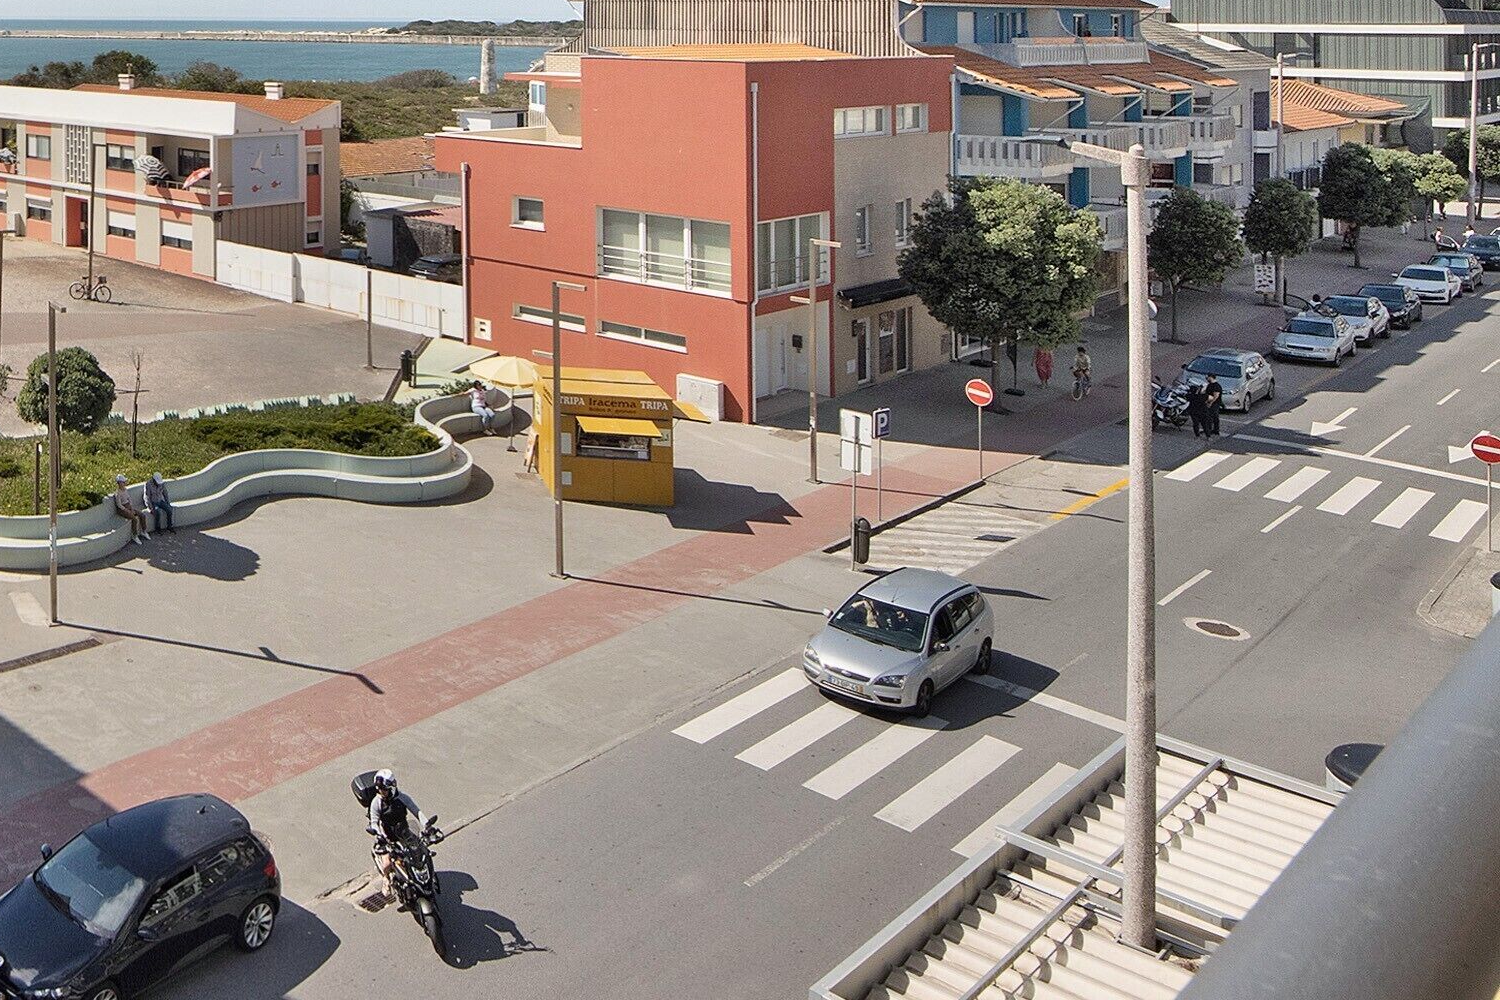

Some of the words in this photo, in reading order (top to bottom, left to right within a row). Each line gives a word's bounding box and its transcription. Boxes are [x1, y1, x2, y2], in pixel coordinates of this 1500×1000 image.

[589, 397, 637, 408] Iracema
[640, 400, 669, 411] TRIPA
[877, 413, 888, 436] P
